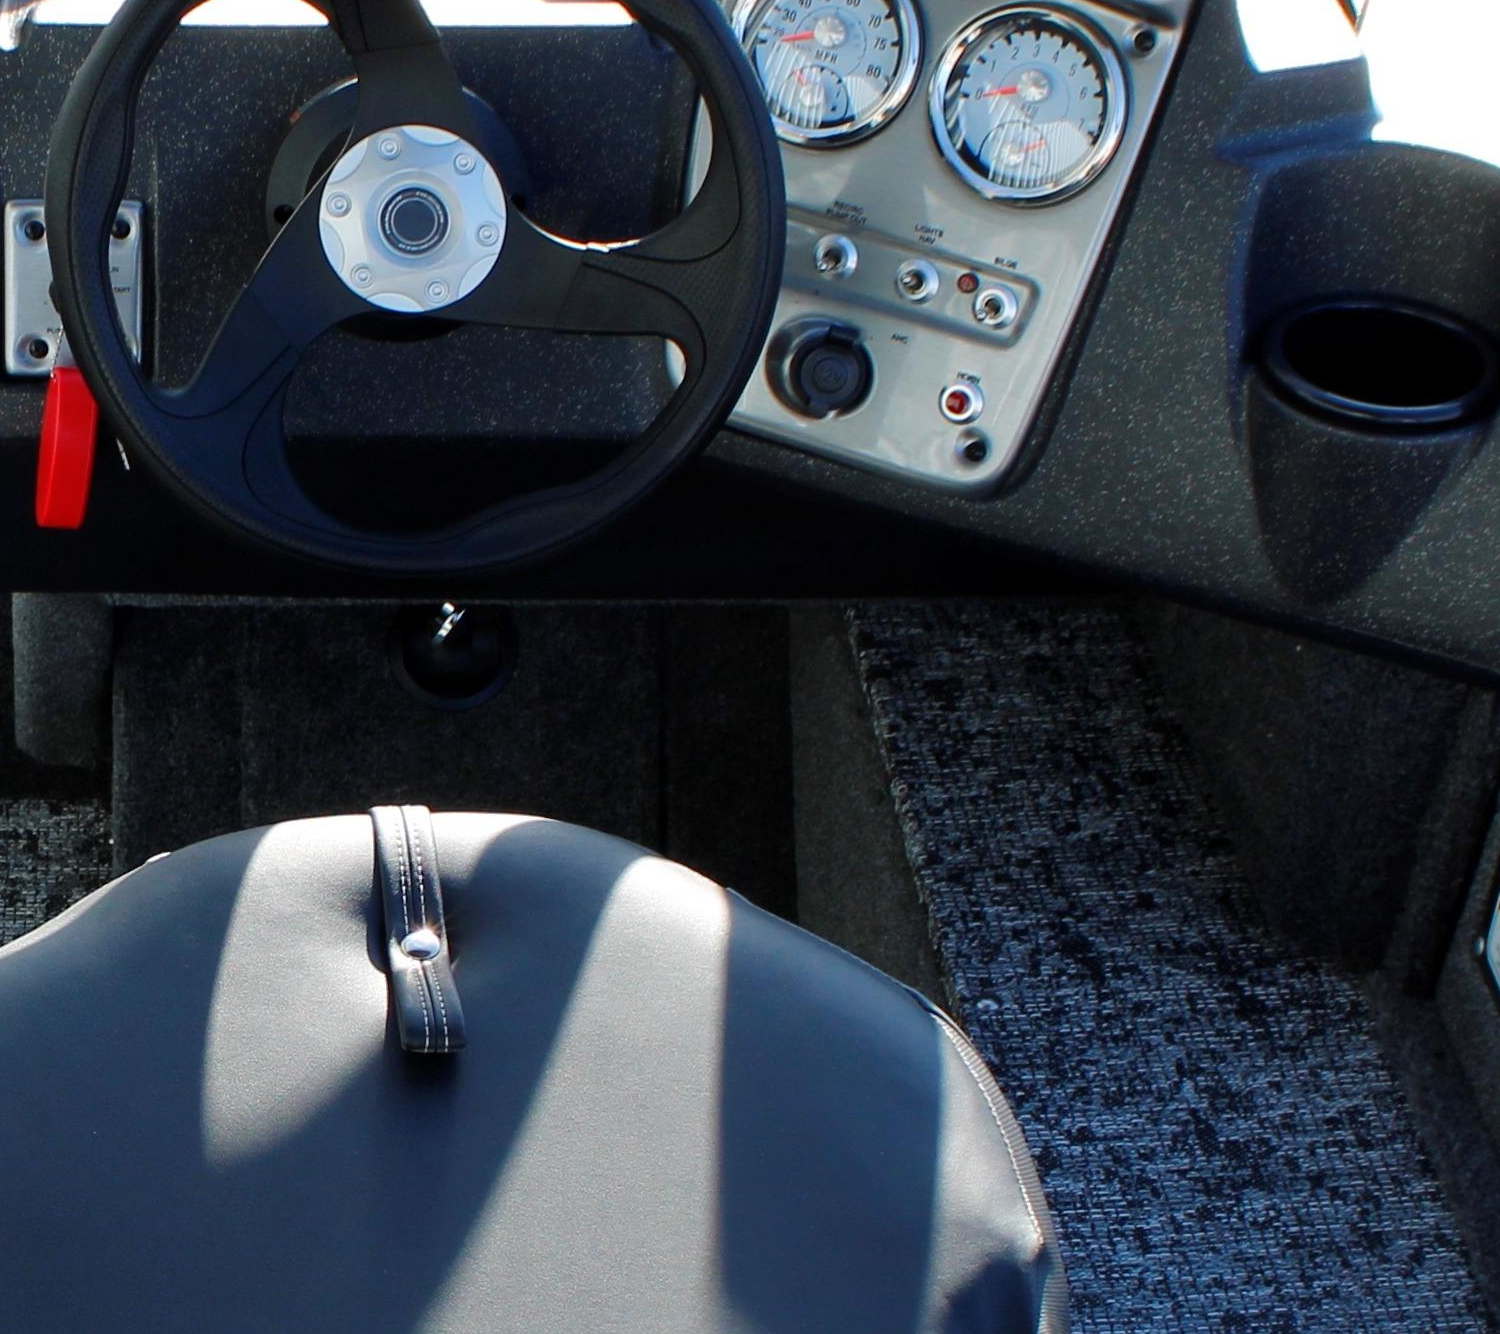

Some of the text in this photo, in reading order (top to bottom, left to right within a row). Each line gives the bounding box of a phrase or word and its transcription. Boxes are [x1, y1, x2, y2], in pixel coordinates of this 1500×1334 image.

[782, 8, 797, 23] 30
[869, 14, 882, 29] 70
[873, 37, 887, 51] 75
[814, 49, 839, 63] MPH
[1011, 45, 1020, 60] 2
[1032, 44, 1041, 59] 3
[1052, 49, 1060, 64] 4
[866, 64, 882, 78] 80
[990, 59, 997, 73] 1
[1068, 62, 1077, 77] 5
[1079, 85, 1088, 99] 6
[914, 223, 944, 238] LIGHTS
[918, 234, 936, 245] NAV
[994, 256, 1018, 270] BILGE
[890, 332, 909, 344] ANC
[957, 370, 981, 384] HORN
